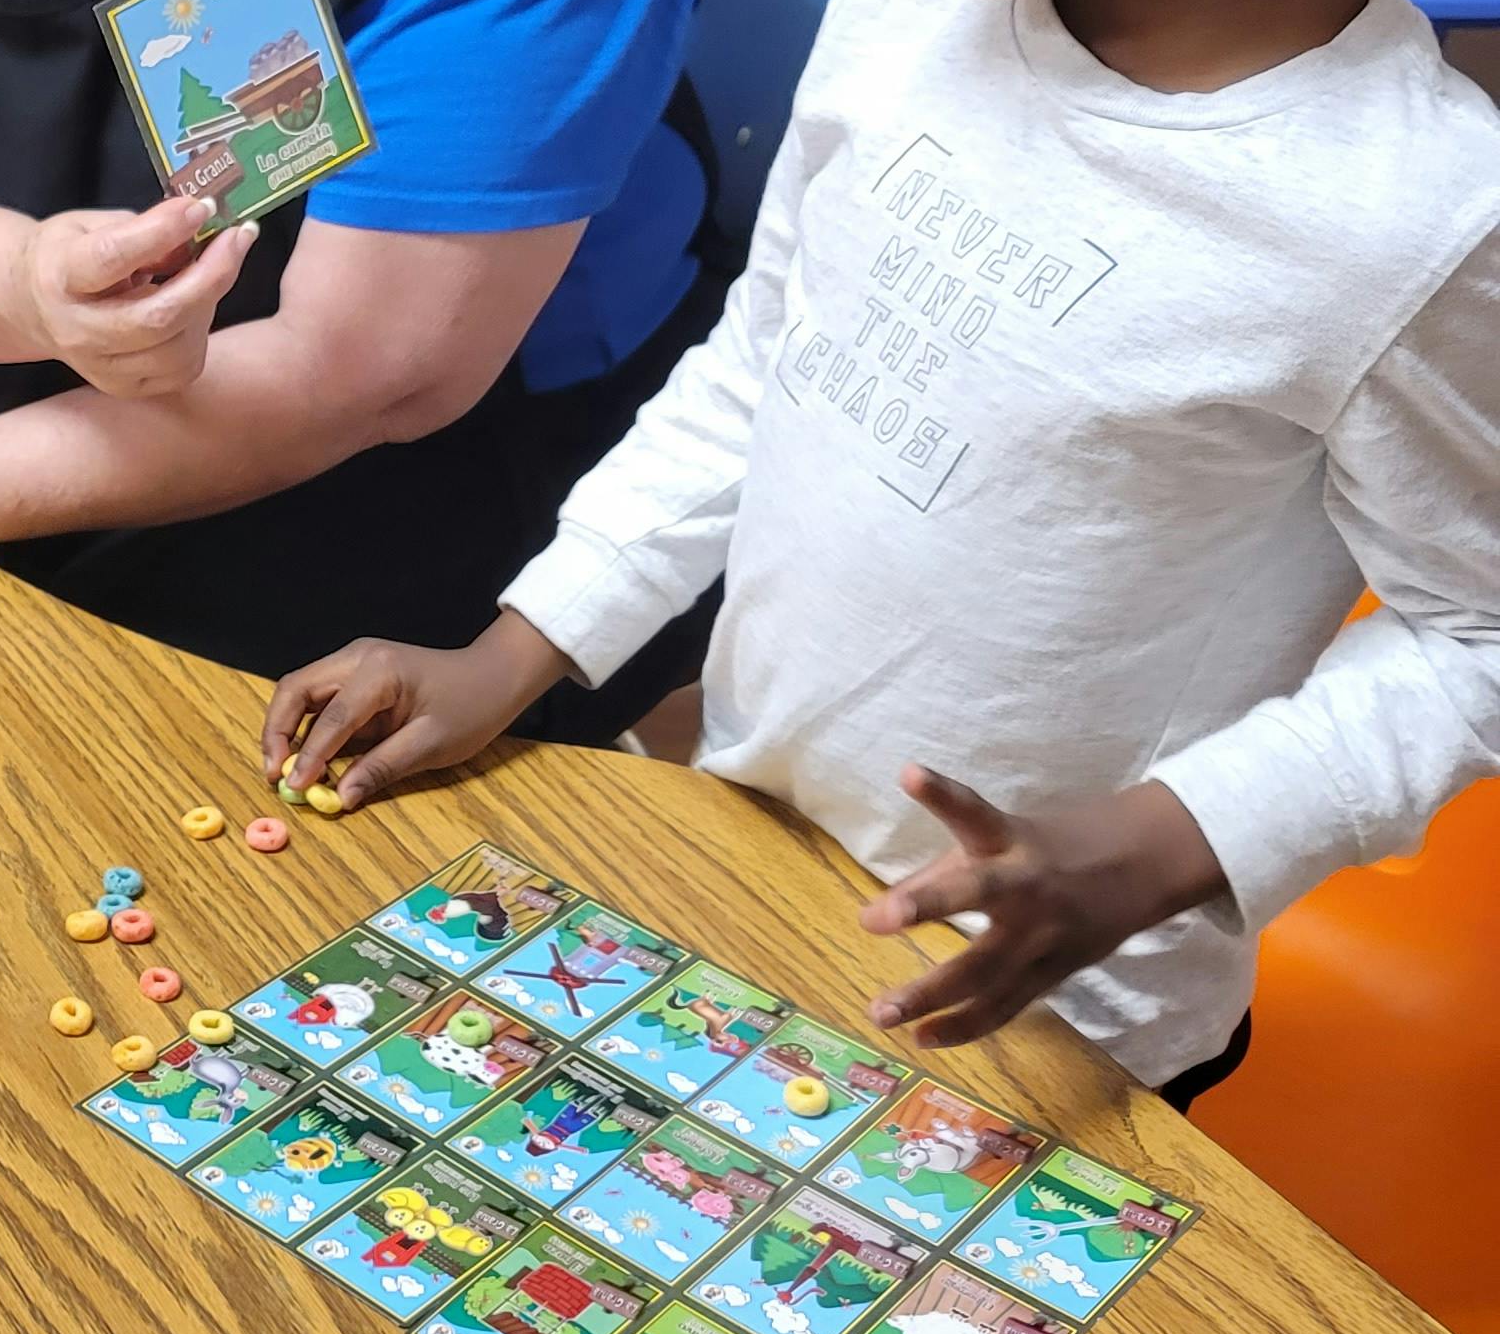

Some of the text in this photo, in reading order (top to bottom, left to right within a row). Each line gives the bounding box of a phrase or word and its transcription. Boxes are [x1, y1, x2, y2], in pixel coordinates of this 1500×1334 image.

[179, 178, 198, 198] La
[255, 153, 278, 173] La
[886, 168, 1074, 309] NEVER
[854, 297, 950, 394] THE
[796, 332, 949, 469] CHAOS
